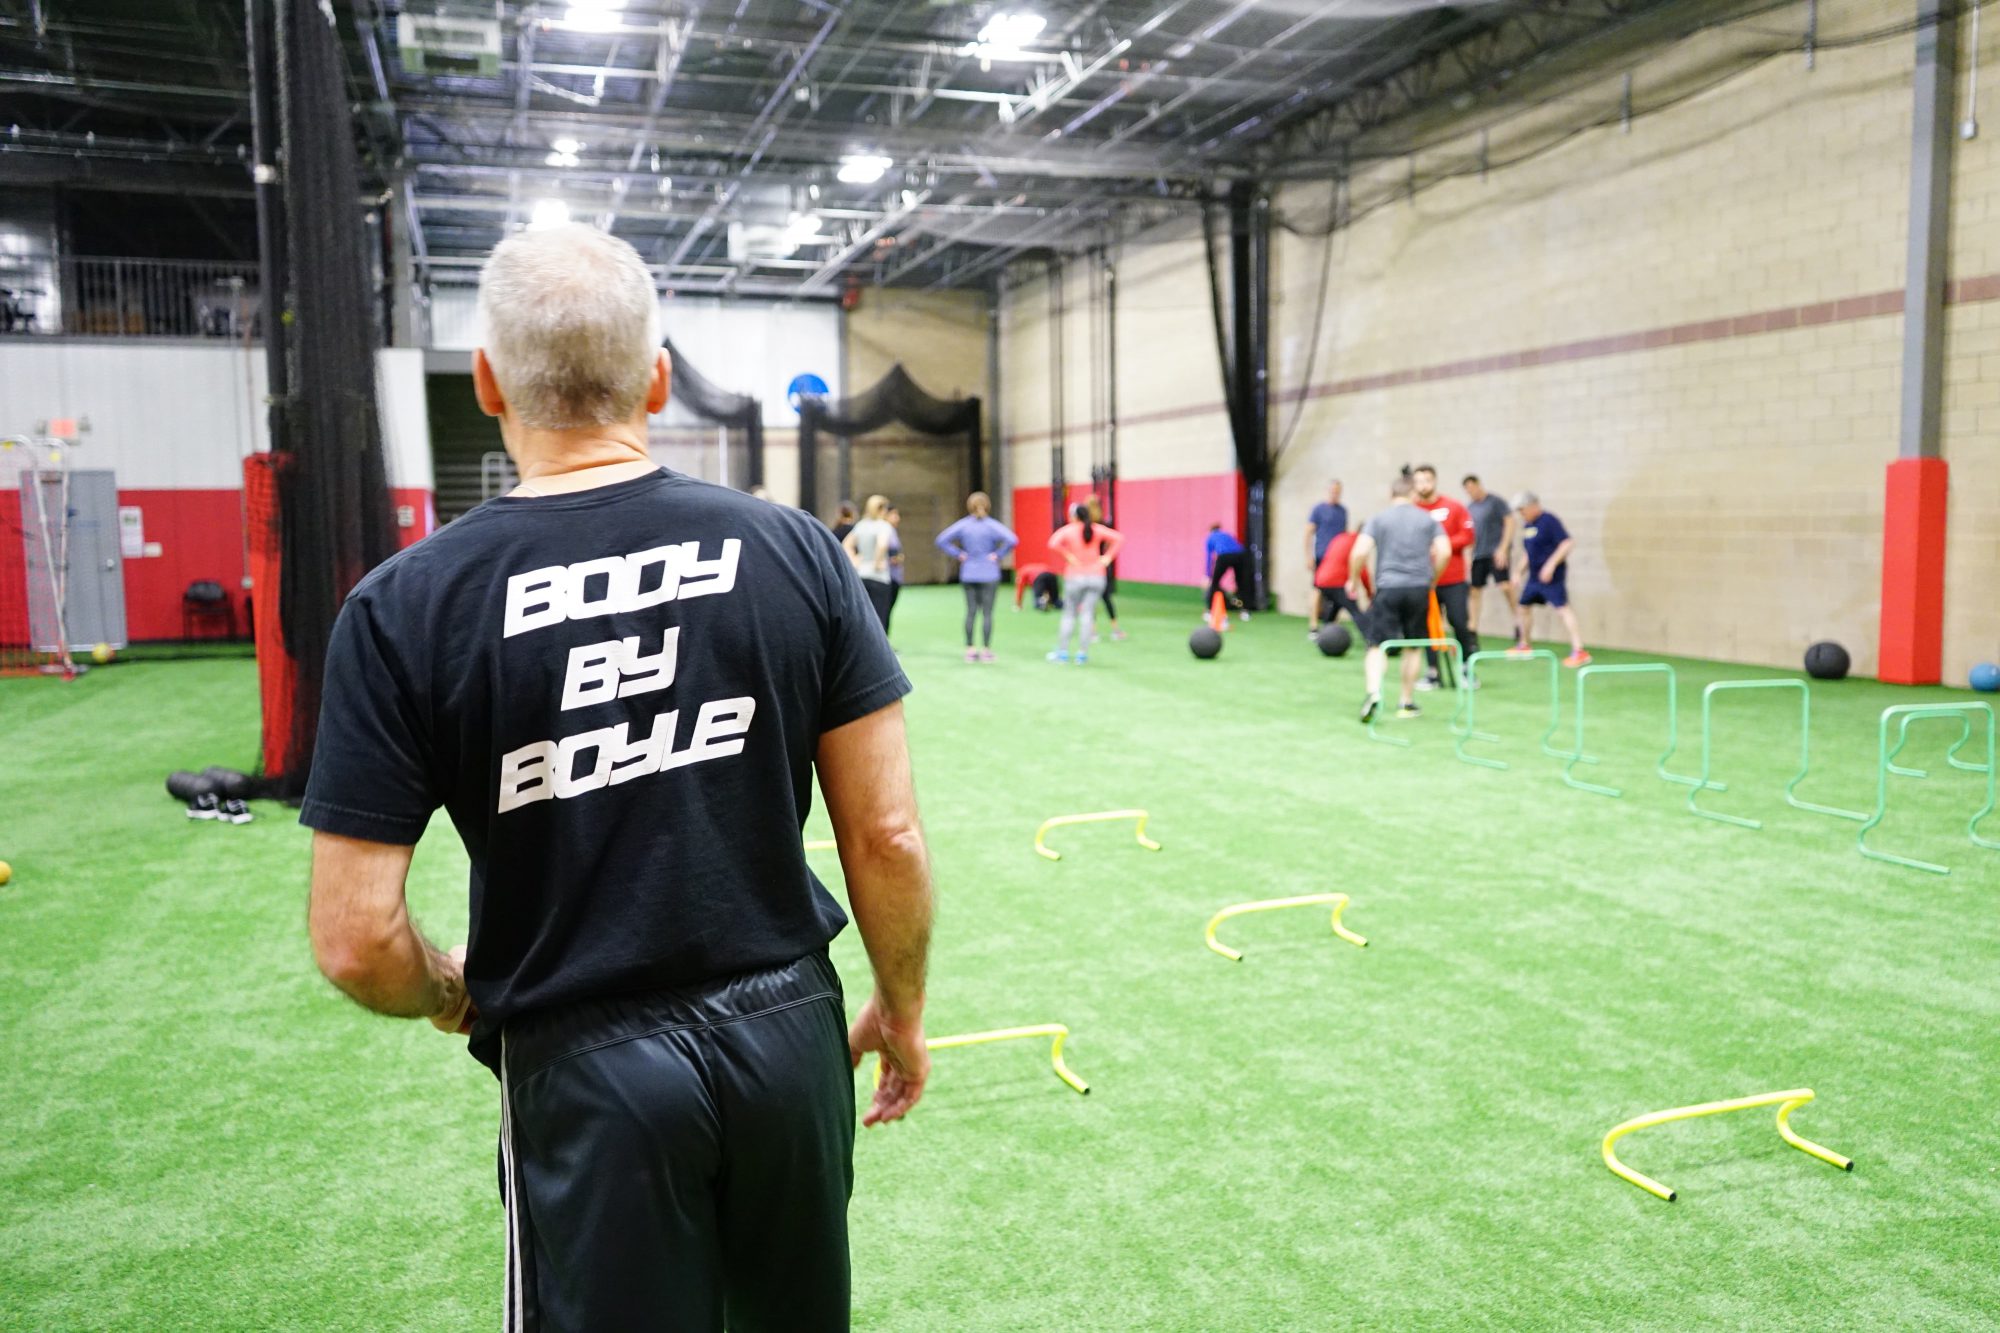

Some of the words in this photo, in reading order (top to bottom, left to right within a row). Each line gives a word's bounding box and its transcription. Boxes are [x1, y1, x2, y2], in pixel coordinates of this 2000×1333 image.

[503, 538, 742, 638] BODY
[560, 626, 680, 712] BY
[497, 696, 756, 814] BOYLE
